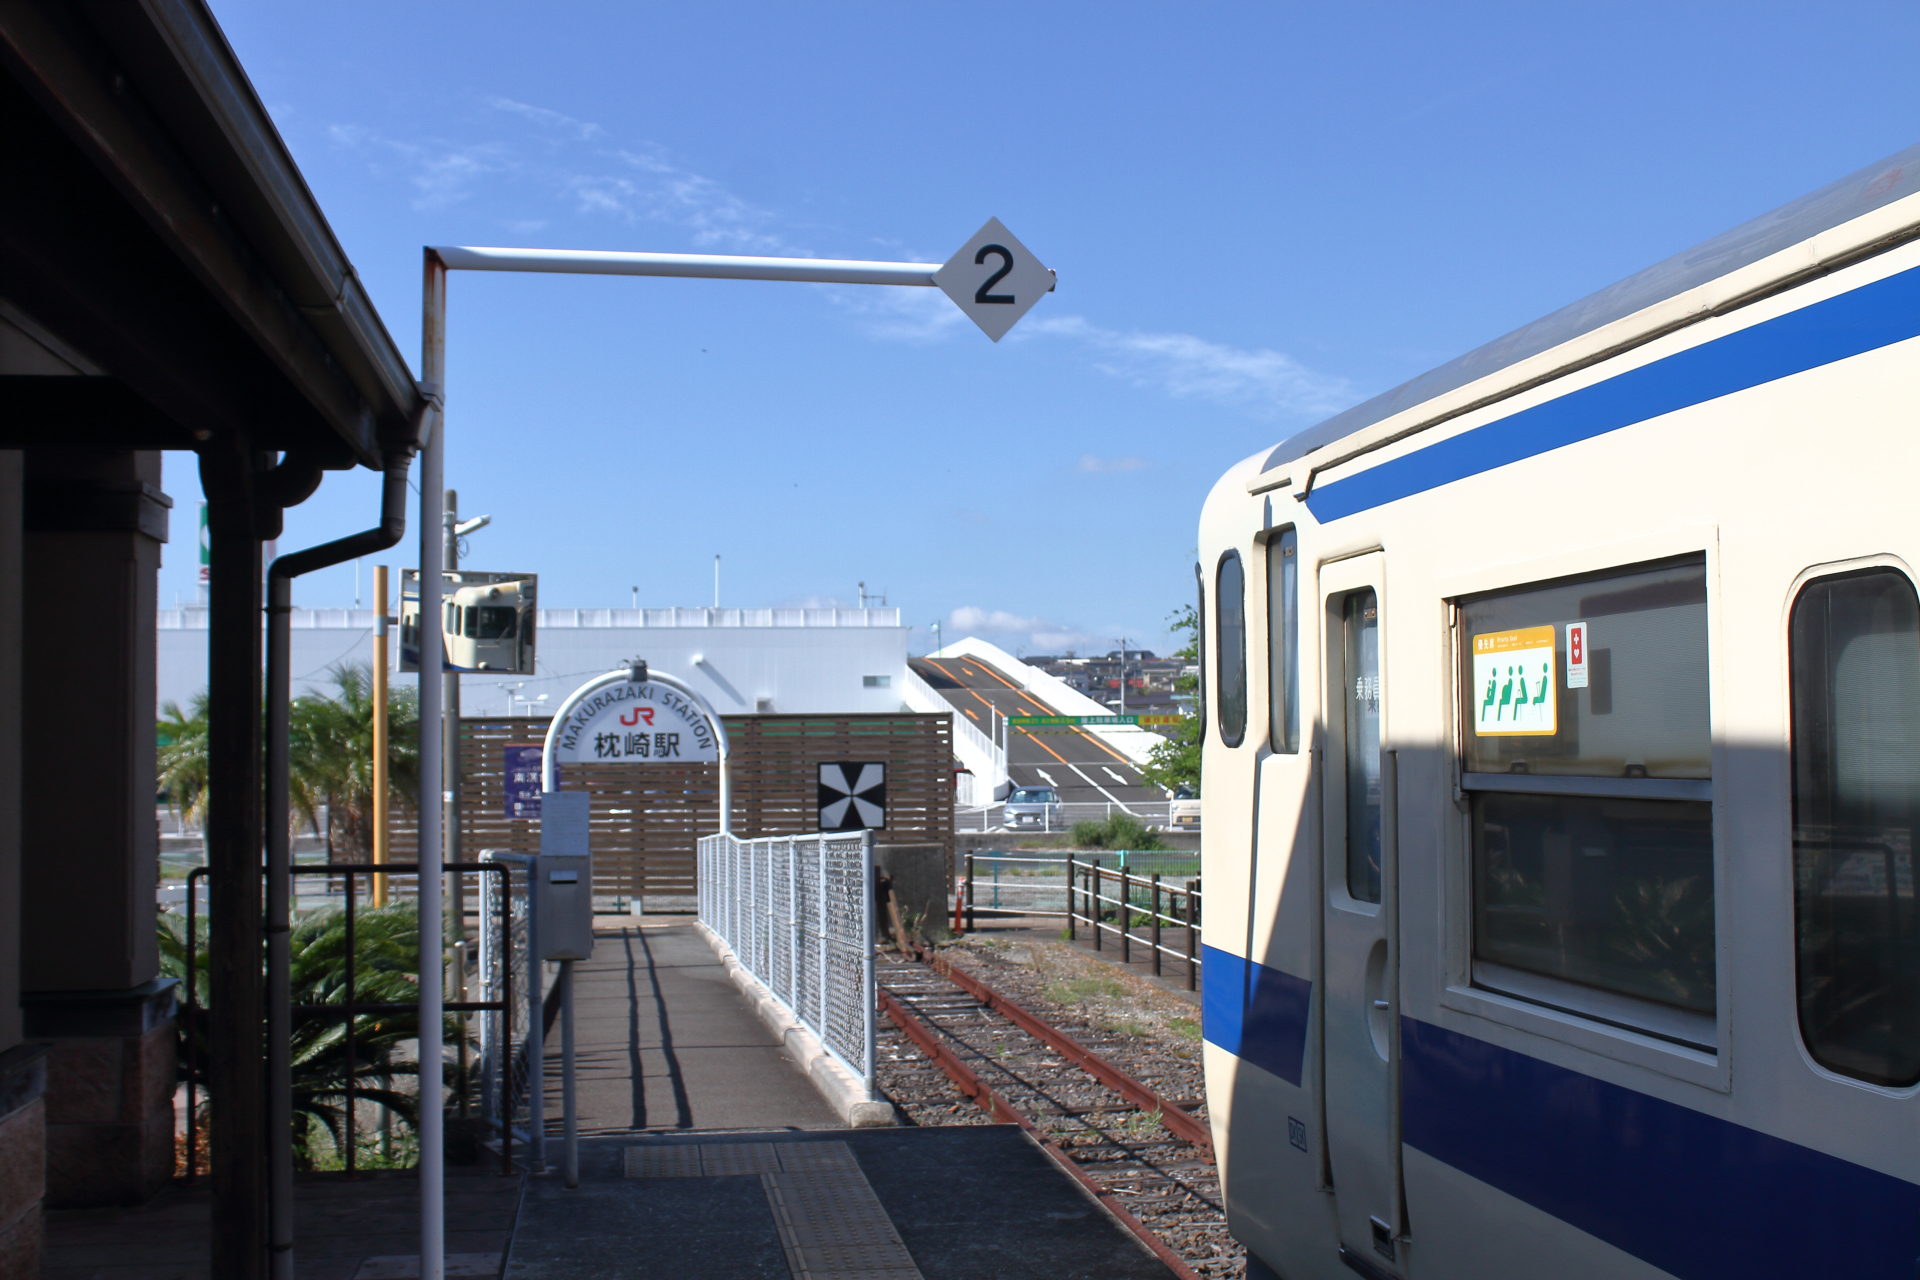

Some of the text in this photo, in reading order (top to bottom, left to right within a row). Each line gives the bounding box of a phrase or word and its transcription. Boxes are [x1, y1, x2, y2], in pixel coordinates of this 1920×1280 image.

[974, 243, 1015, 304] 2
[562, 686, 712, 750] MAKURAZAKI STATION
[619, 707, 655, 727] JR
[594, 732, 680, 758] 枕崎駅
